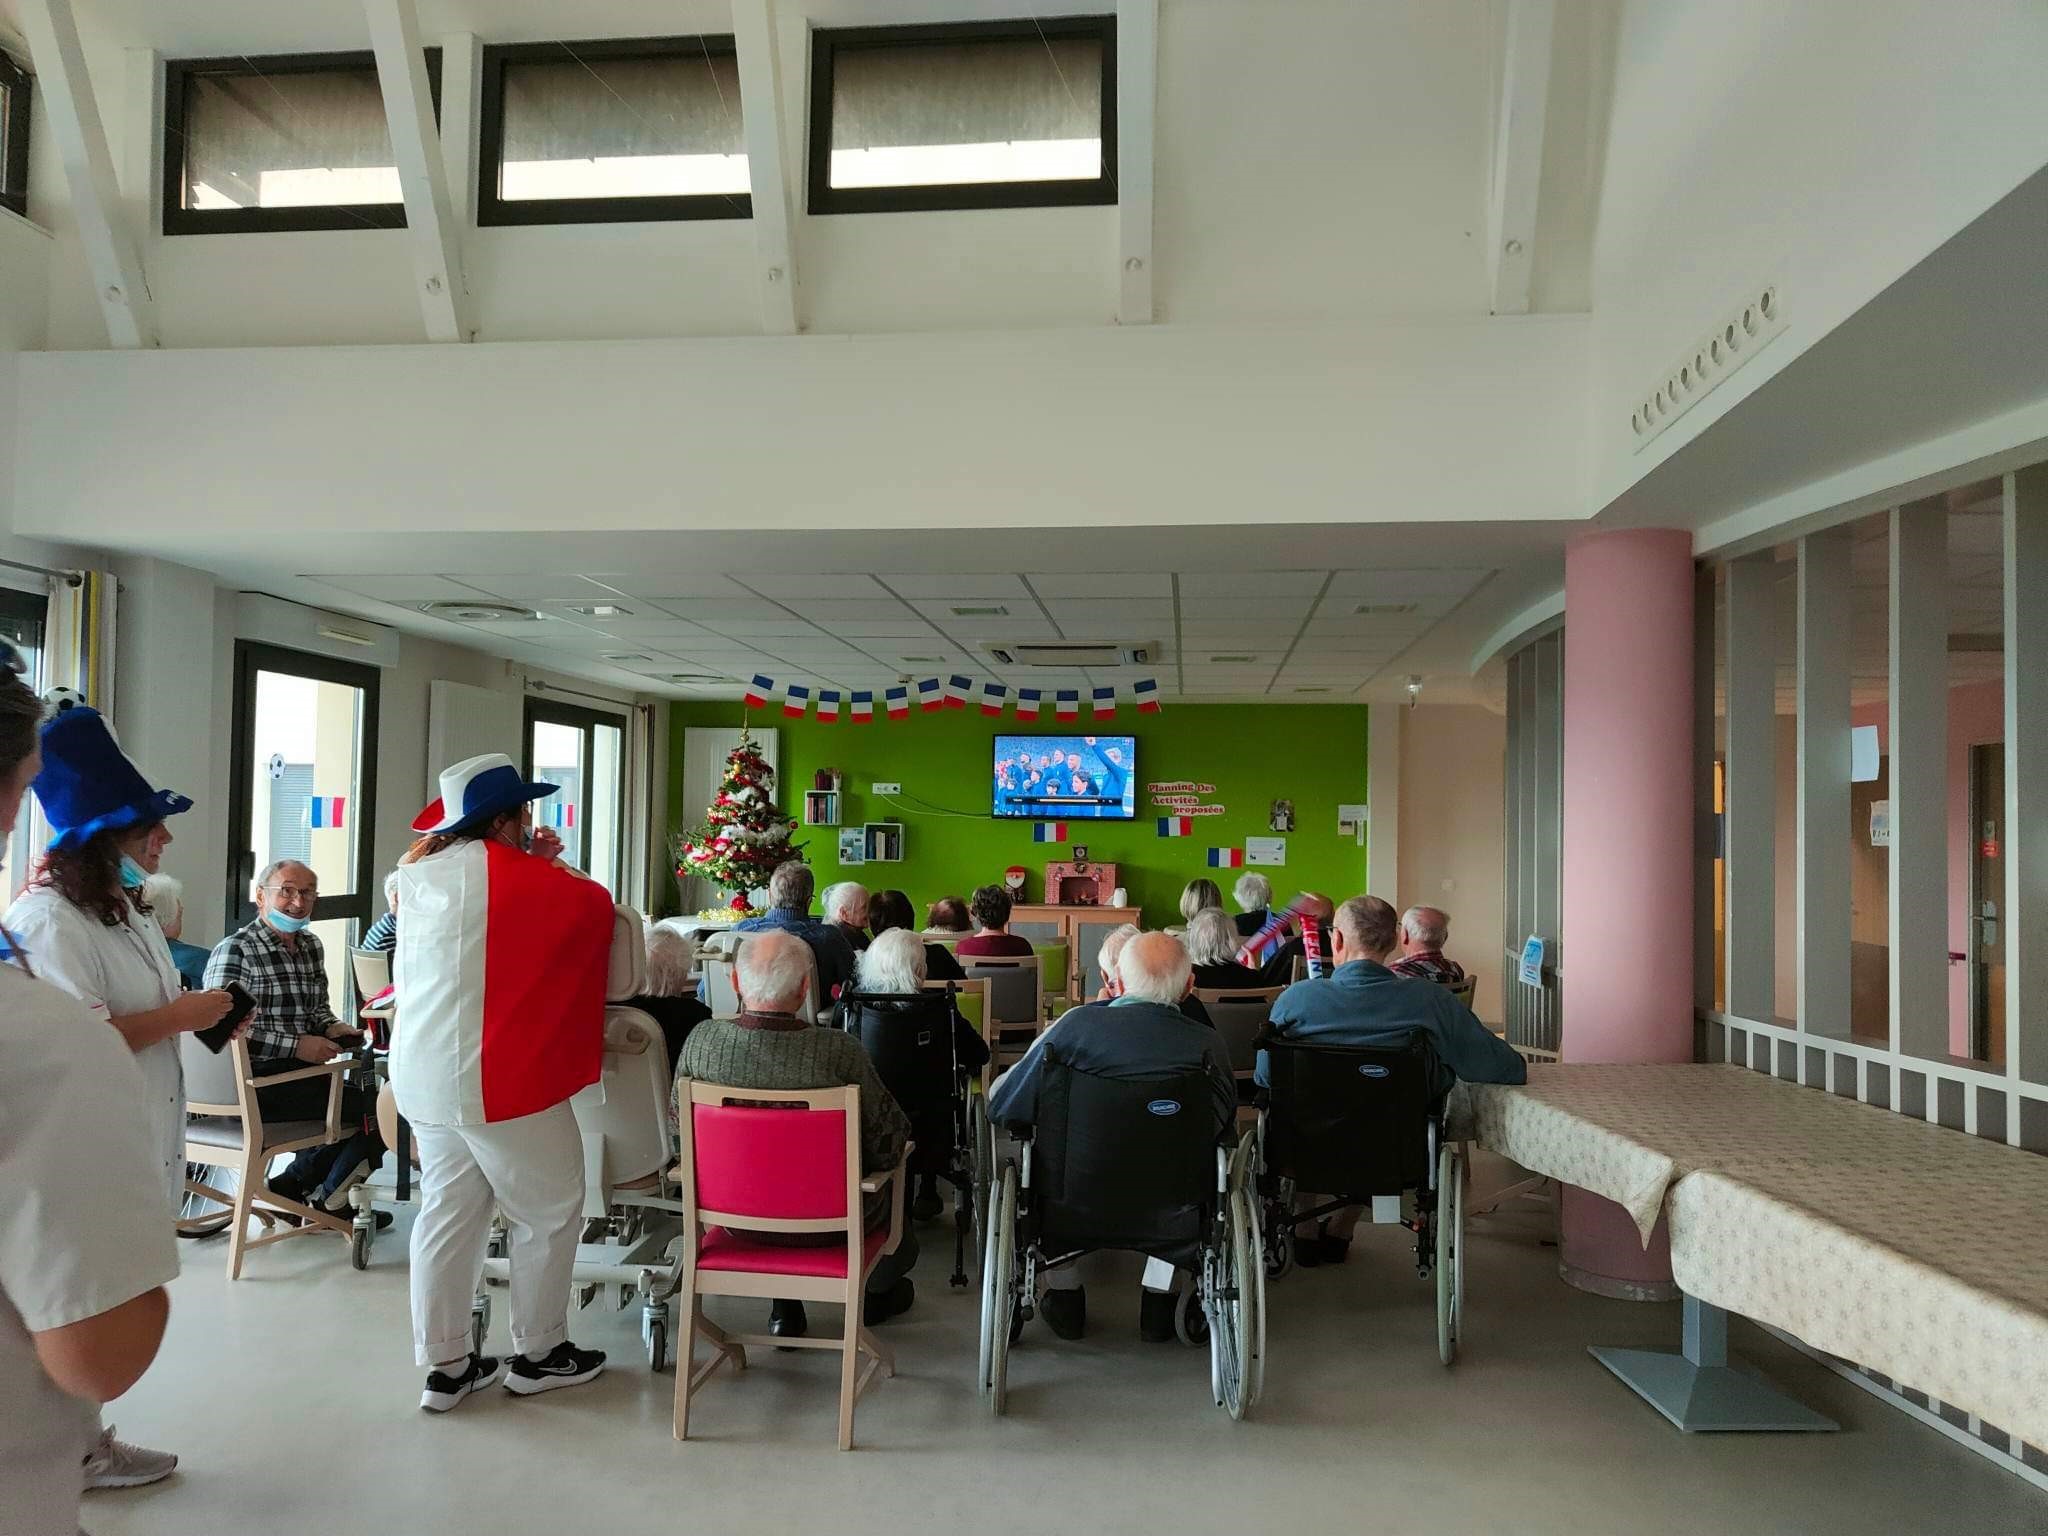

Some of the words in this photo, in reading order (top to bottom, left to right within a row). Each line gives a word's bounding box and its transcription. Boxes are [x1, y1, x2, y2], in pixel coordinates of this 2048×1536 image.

[1148, 784, 1194, 792] Planning
[1197, 784, 1215, 792] Des
[1152, 796, 1198, 804] Activités
[1173, 806, 1223, 815] proposées
